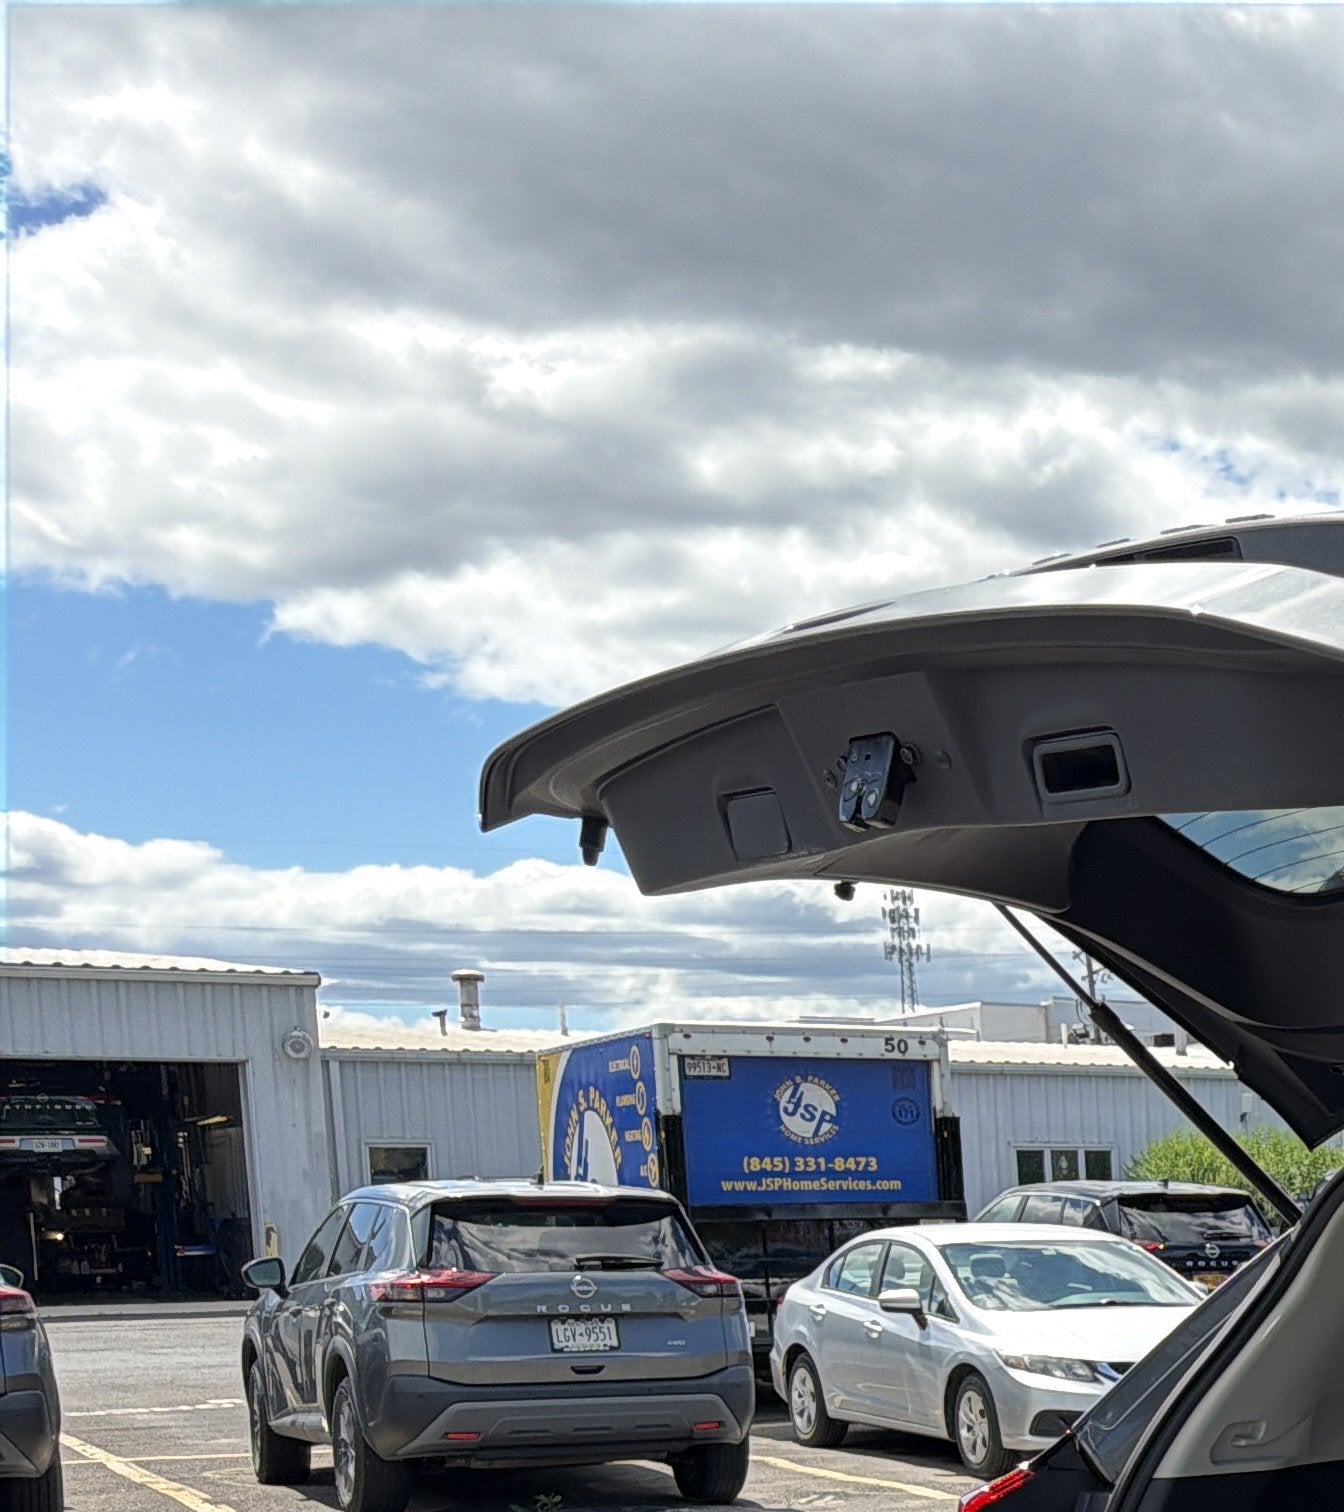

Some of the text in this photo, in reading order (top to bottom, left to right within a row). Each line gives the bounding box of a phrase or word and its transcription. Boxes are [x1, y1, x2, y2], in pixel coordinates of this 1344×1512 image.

[884, 1037, 909, 1054] 50
[743, 1157, 878, 1174] (845) 331-8473
[720, 1177, 902, 1193] www.JSPHomeServices.com
[536, 1303, 632, 1313] ROGUE
